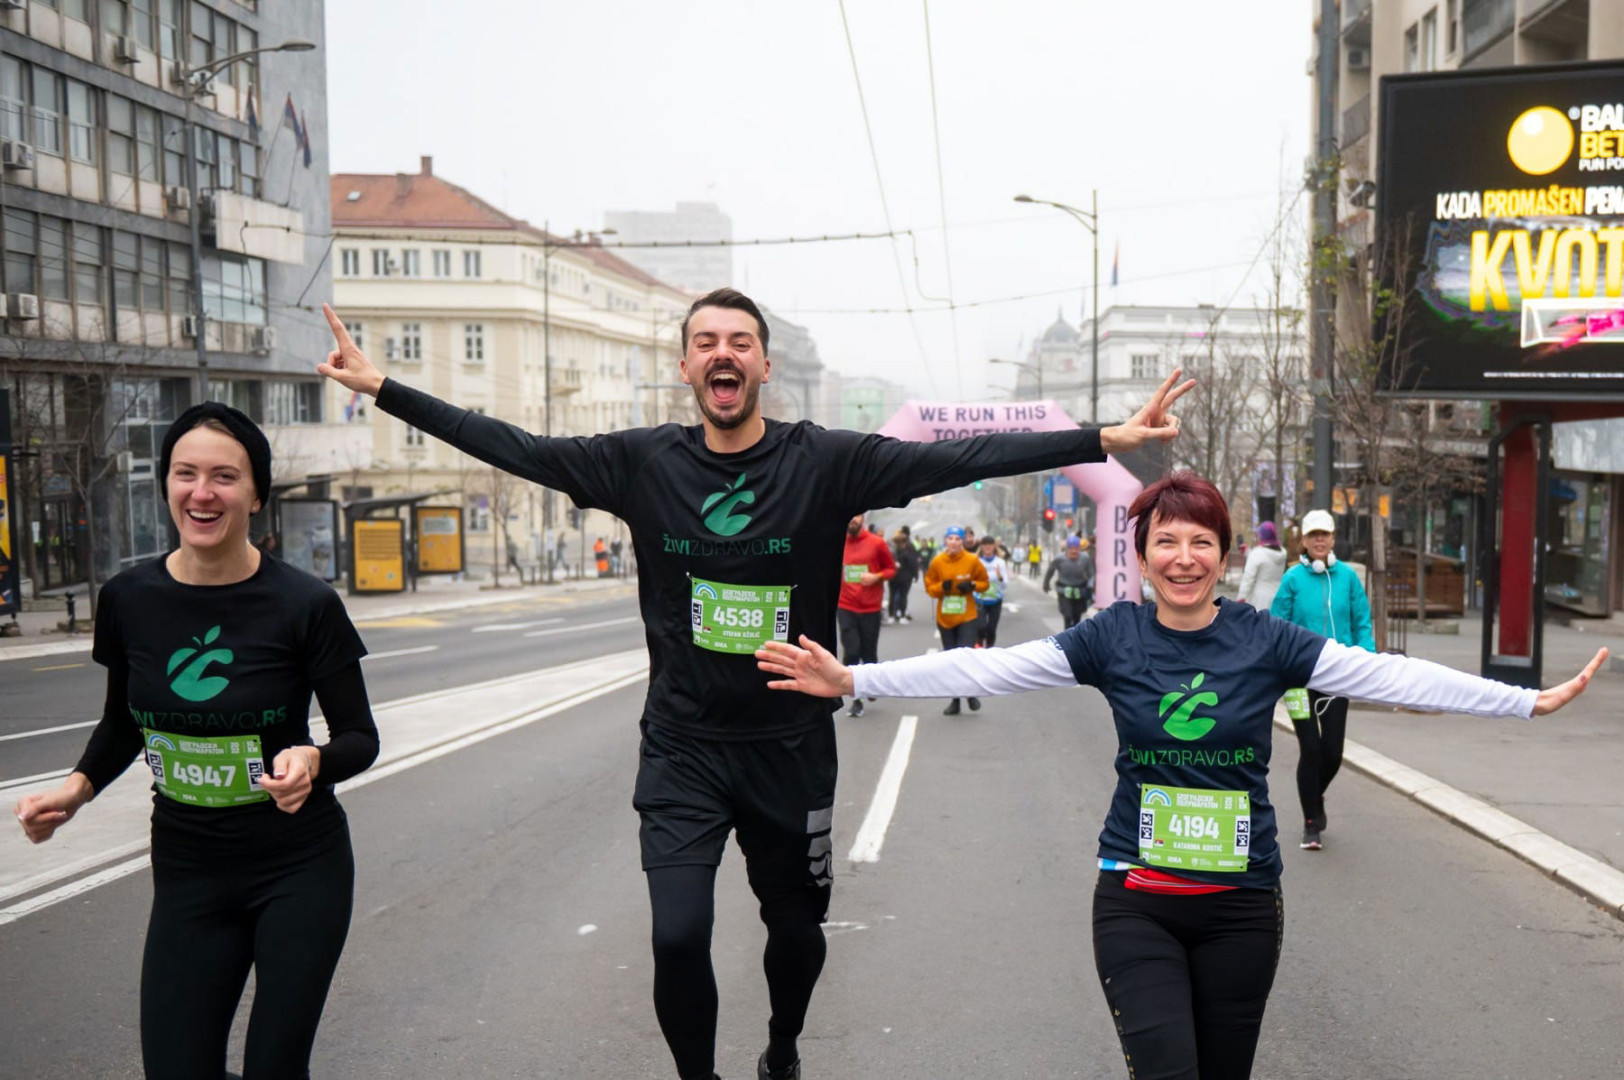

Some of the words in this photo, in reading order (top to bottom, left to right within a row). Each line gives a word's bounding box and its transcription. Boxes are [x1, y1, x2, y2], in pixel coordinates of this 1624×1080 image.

[1436, 192, 1482, 220] KADA
[1483, 184, 1584, 218] PROMAŠEN
[1585, 185, 1624, 214] PEN
[919, 405, 948, 422] WE
[955, 406, 995, 422] RUN
[1003, 405, 1047, 421] THIS
[663, 533, 792, 556] ŽIVIZDRAVO.RS
[713, 605, 764, 628] 4538
[173, 761, 237, 787] 4947
[1169, 814, 1220, 839] 4194
